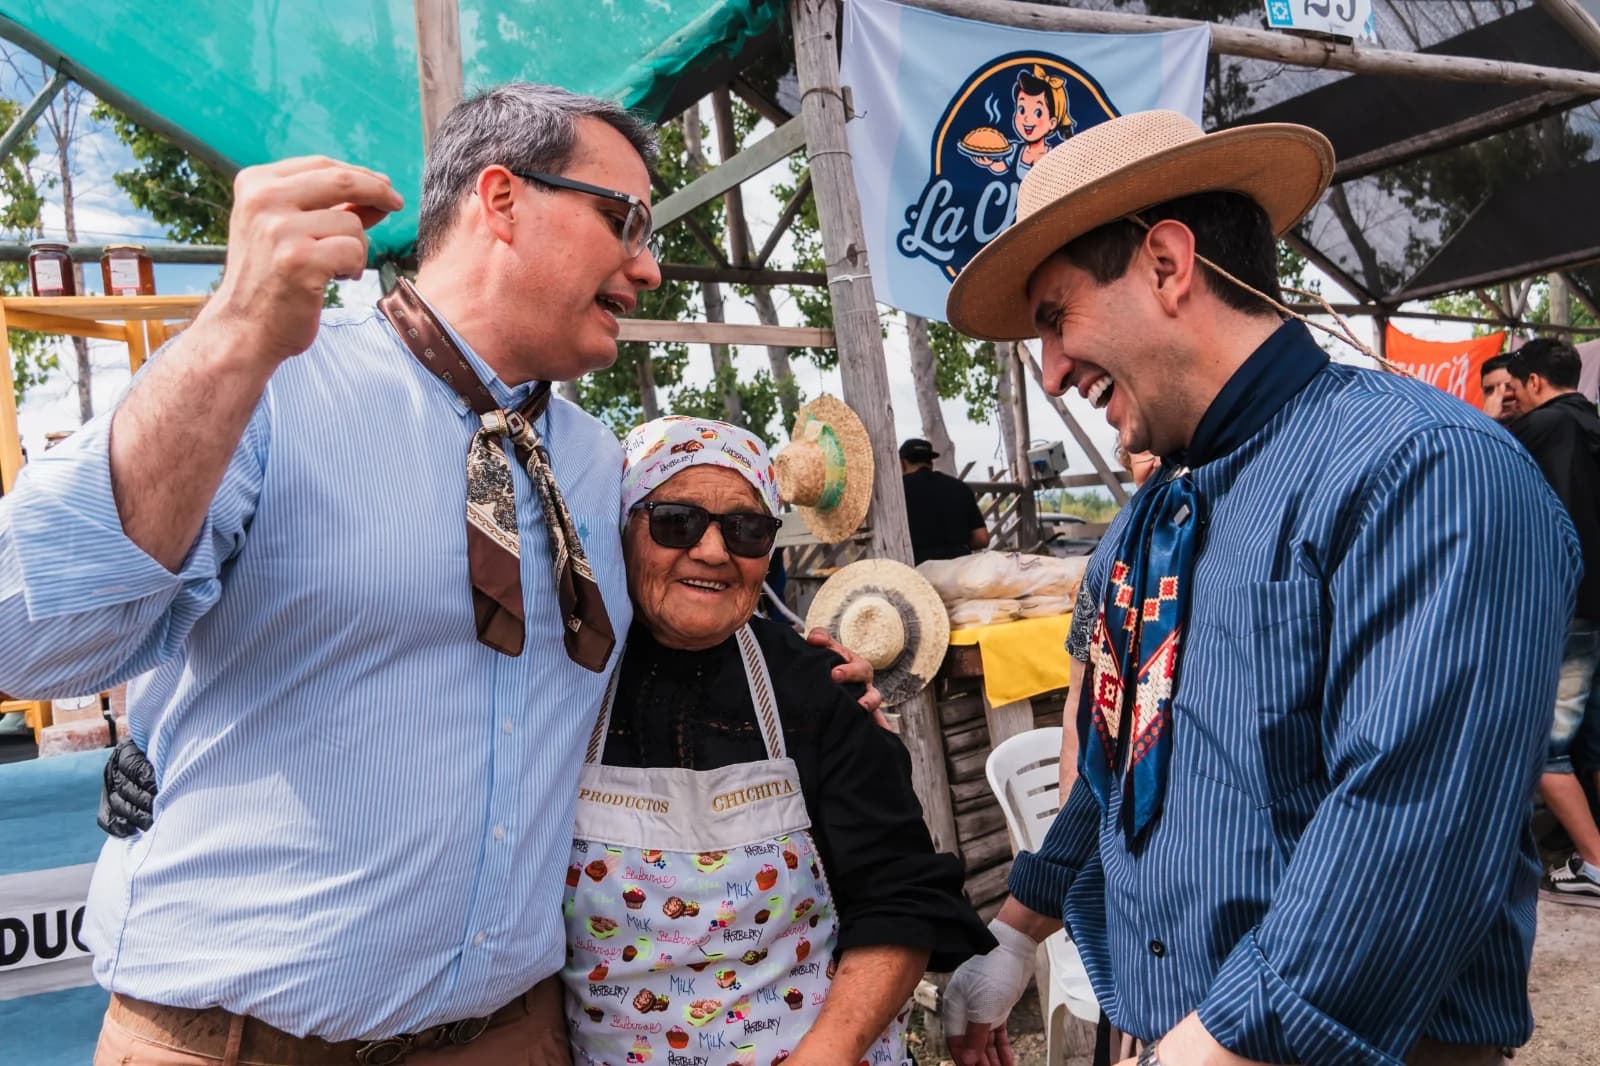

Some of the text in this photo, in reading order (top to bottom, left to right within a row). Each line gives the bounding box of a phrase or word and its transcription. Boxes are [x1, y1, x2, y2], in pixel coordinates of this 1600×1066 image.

[902, 179, 968, 261] La
[579, 779, 794, 813] PRODUCTOS CHICHITA
